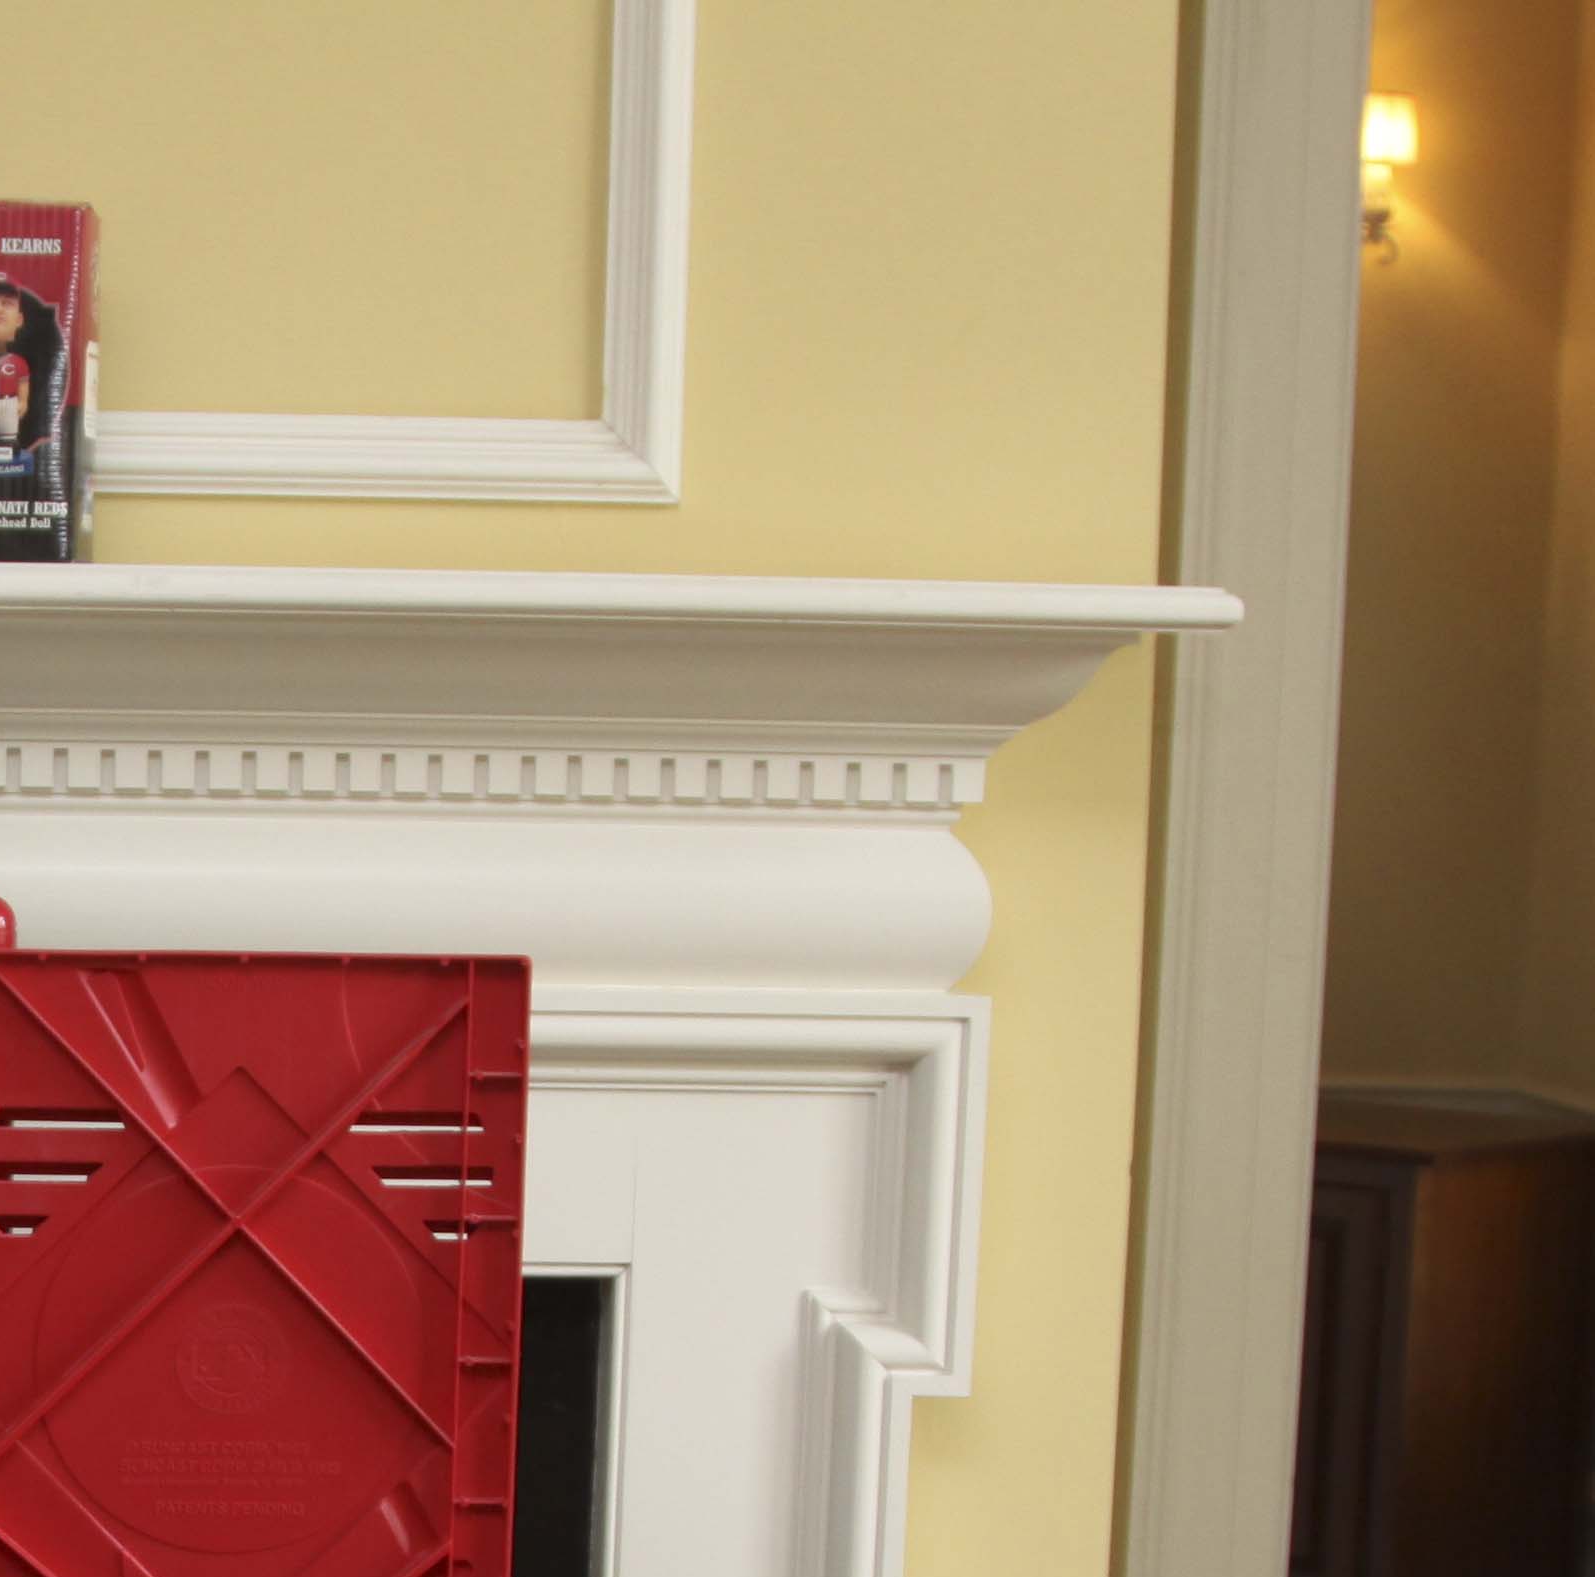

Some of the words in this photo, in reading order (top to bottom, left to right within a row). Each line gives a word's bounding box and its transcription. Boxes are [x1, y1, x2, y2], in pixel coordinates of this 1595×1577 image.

[1, 238, 62, 254] KEARNS
[34, 502, 68, 516] REDS
[30, 518, 52, 529] Doll
